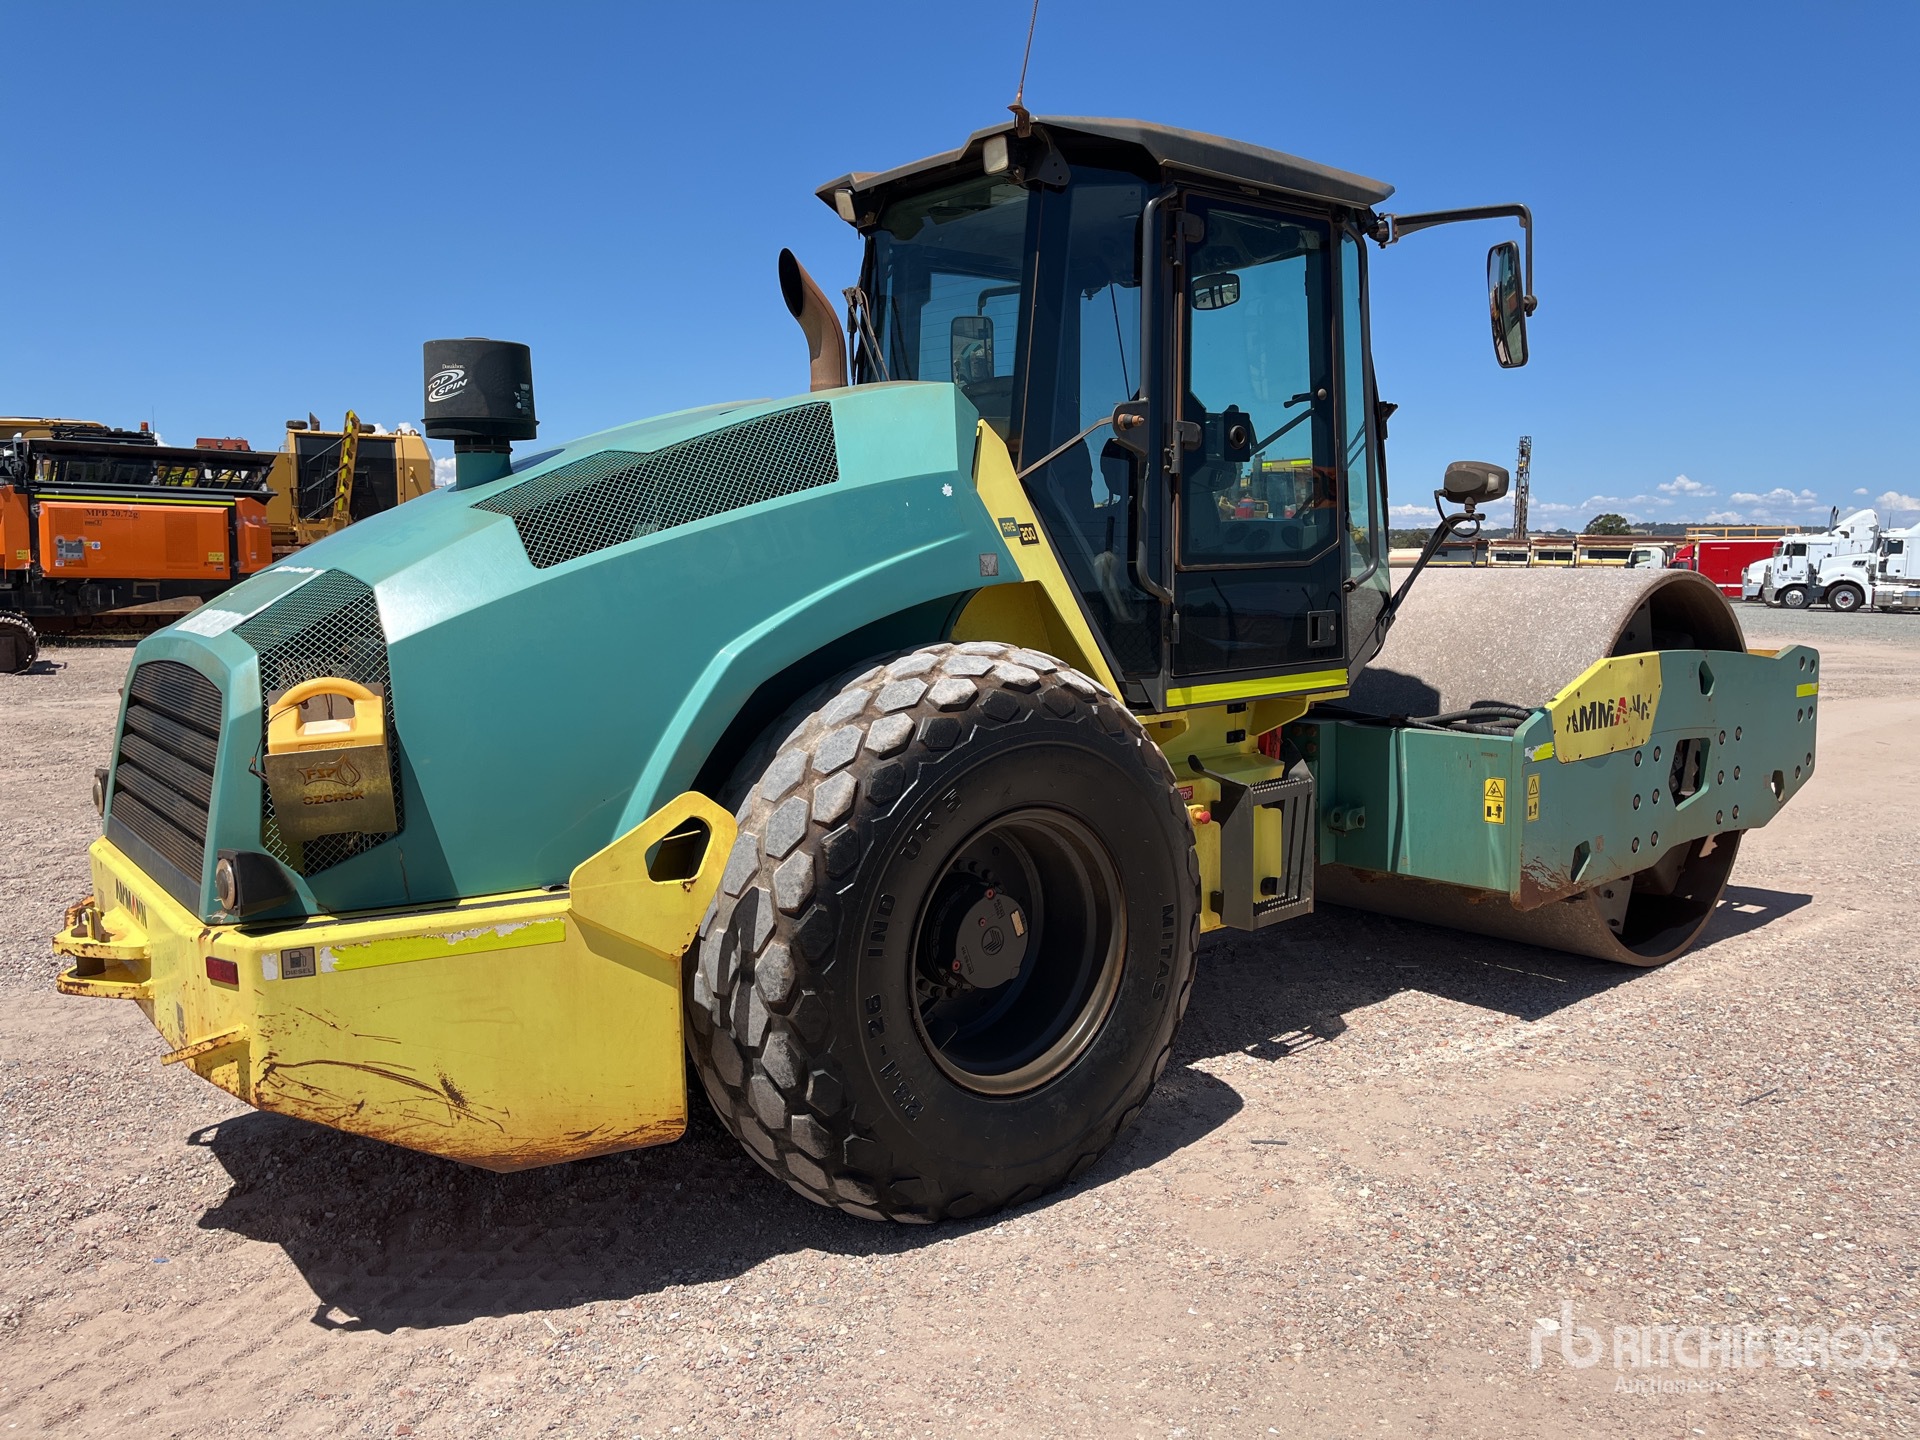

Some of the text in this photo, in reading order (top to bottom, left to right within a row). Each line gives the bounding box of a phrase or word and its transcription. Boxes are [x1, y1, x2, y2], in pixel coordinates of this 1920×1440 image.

[428, 376, 449, 391] TOP
[438, 379, 468, 396] SPIN
[86, 509, 109, 517] MPB
[1020, 527, 1036, 541] 200
[1152, 903, 1175, 1000] MITAS
[285, 967, 313, 976] DIESEL
